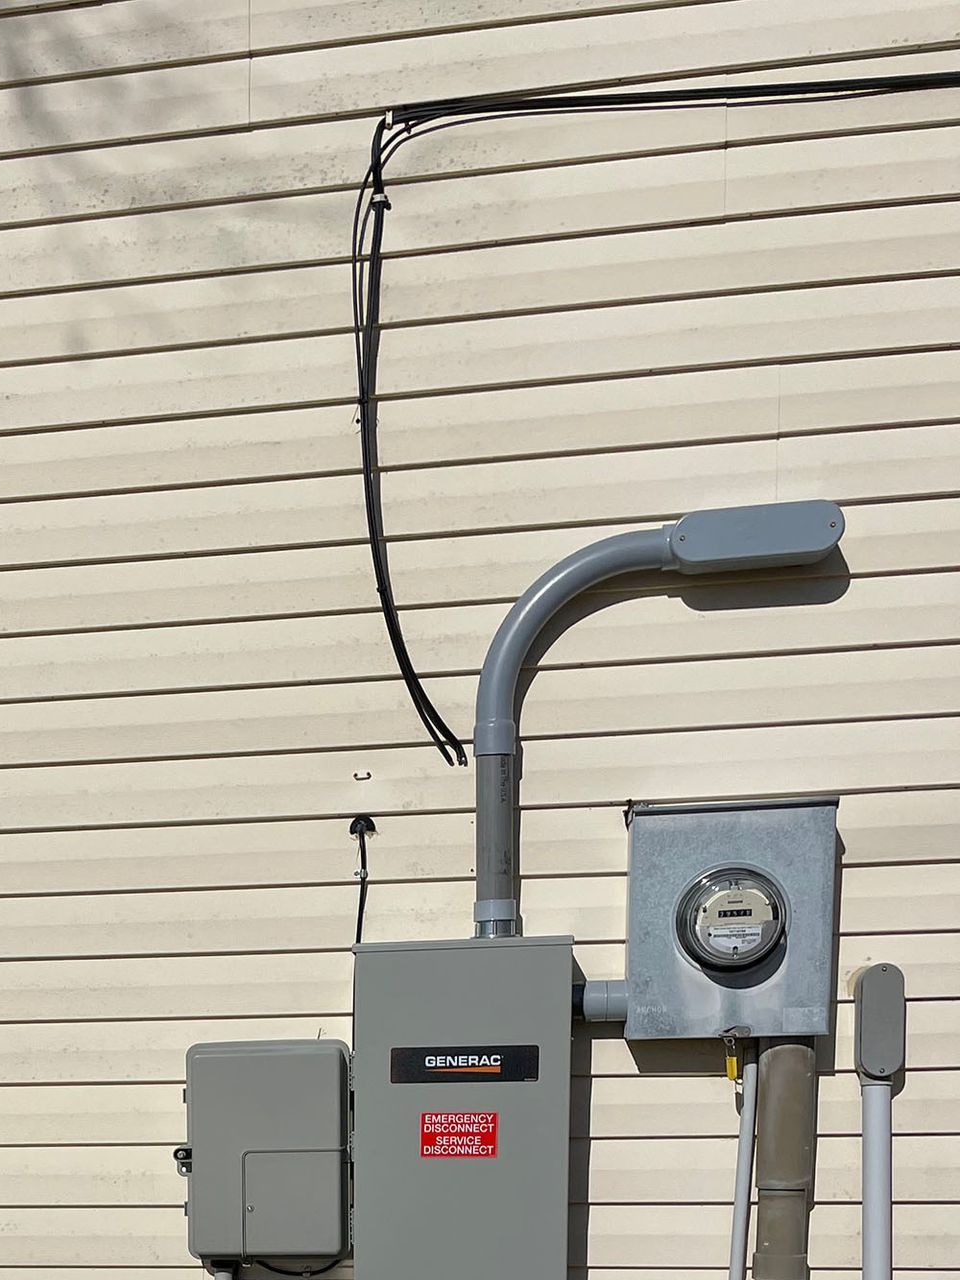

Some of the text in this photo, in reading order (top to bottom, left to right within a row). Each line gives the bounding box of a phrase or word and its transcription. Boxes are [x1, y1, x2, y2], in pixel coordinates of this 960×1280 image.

[424, 1054, 502, 1067] GENERAC
[424, 1114, 494, 1124] EMERGENCY
[423, 1123, 494, 1133] DISCONNECT
[435, 1136, 481, 1145] SERVICE
[423, 1145, 494, 1155] DISCONNECT
